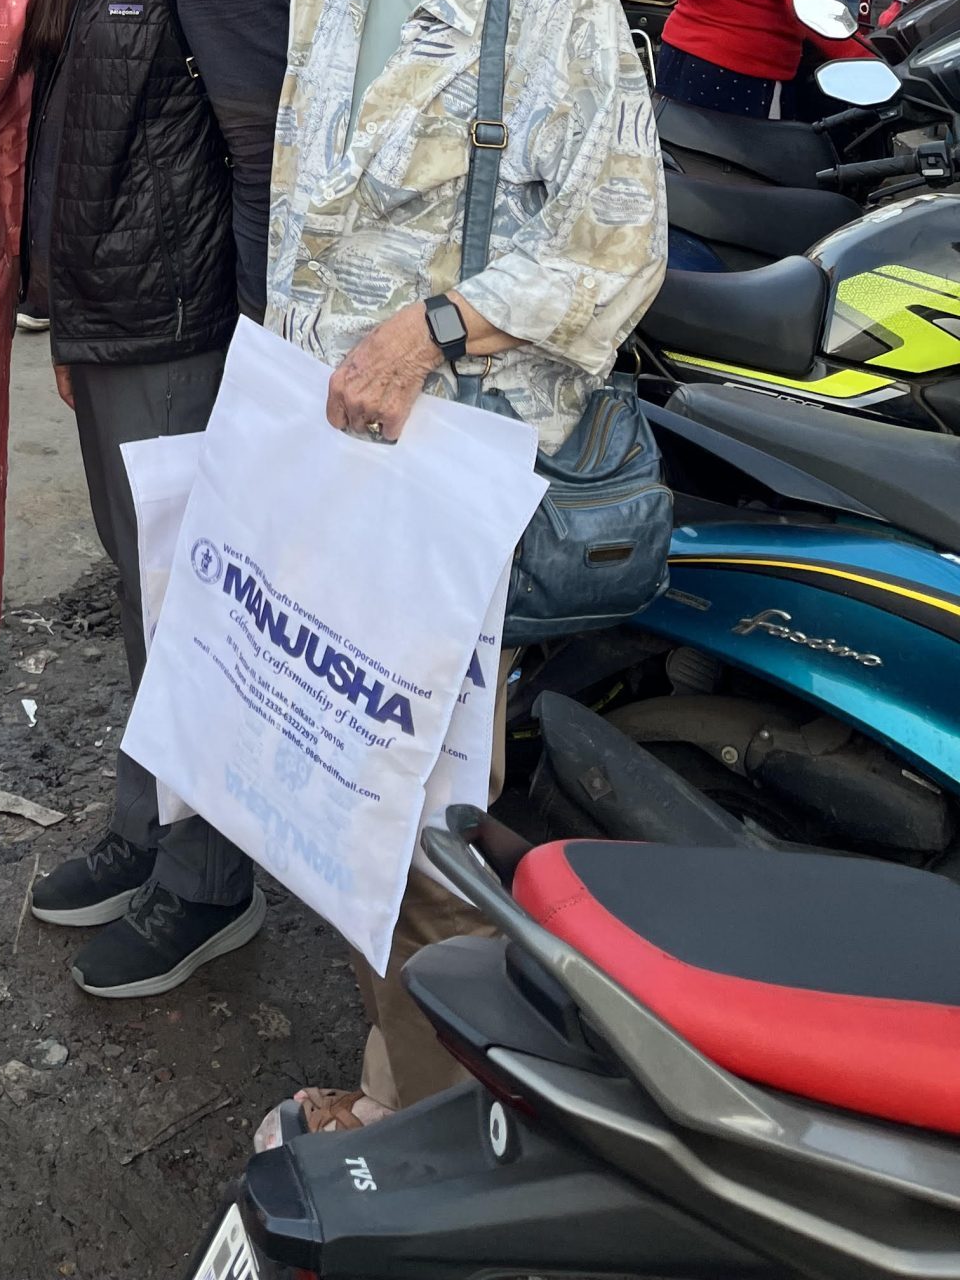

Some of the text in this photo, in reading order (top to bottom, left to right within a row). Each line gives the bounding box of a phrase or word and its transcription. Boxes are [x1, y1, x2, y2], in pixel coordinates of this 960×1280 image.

[222, 562, 416, 737] MANJUSHA
[223, 542, 244, 561] West
[292, 601, 343, 645] Development
[343, 639, 390, 679] Corporation
[391, 672, 433, 700] Limited
[249, 682, 265, 704] (033)
[262, 649, 333, 712] Craftsmanship
[335, 707, 351, 724] of
[348, 715, 398, 751] Bengal
[290, 701, 316, 728] Kolkata
[320, 726, 345, 751] 700106
[345, 1156, 378, 1192] TVS
